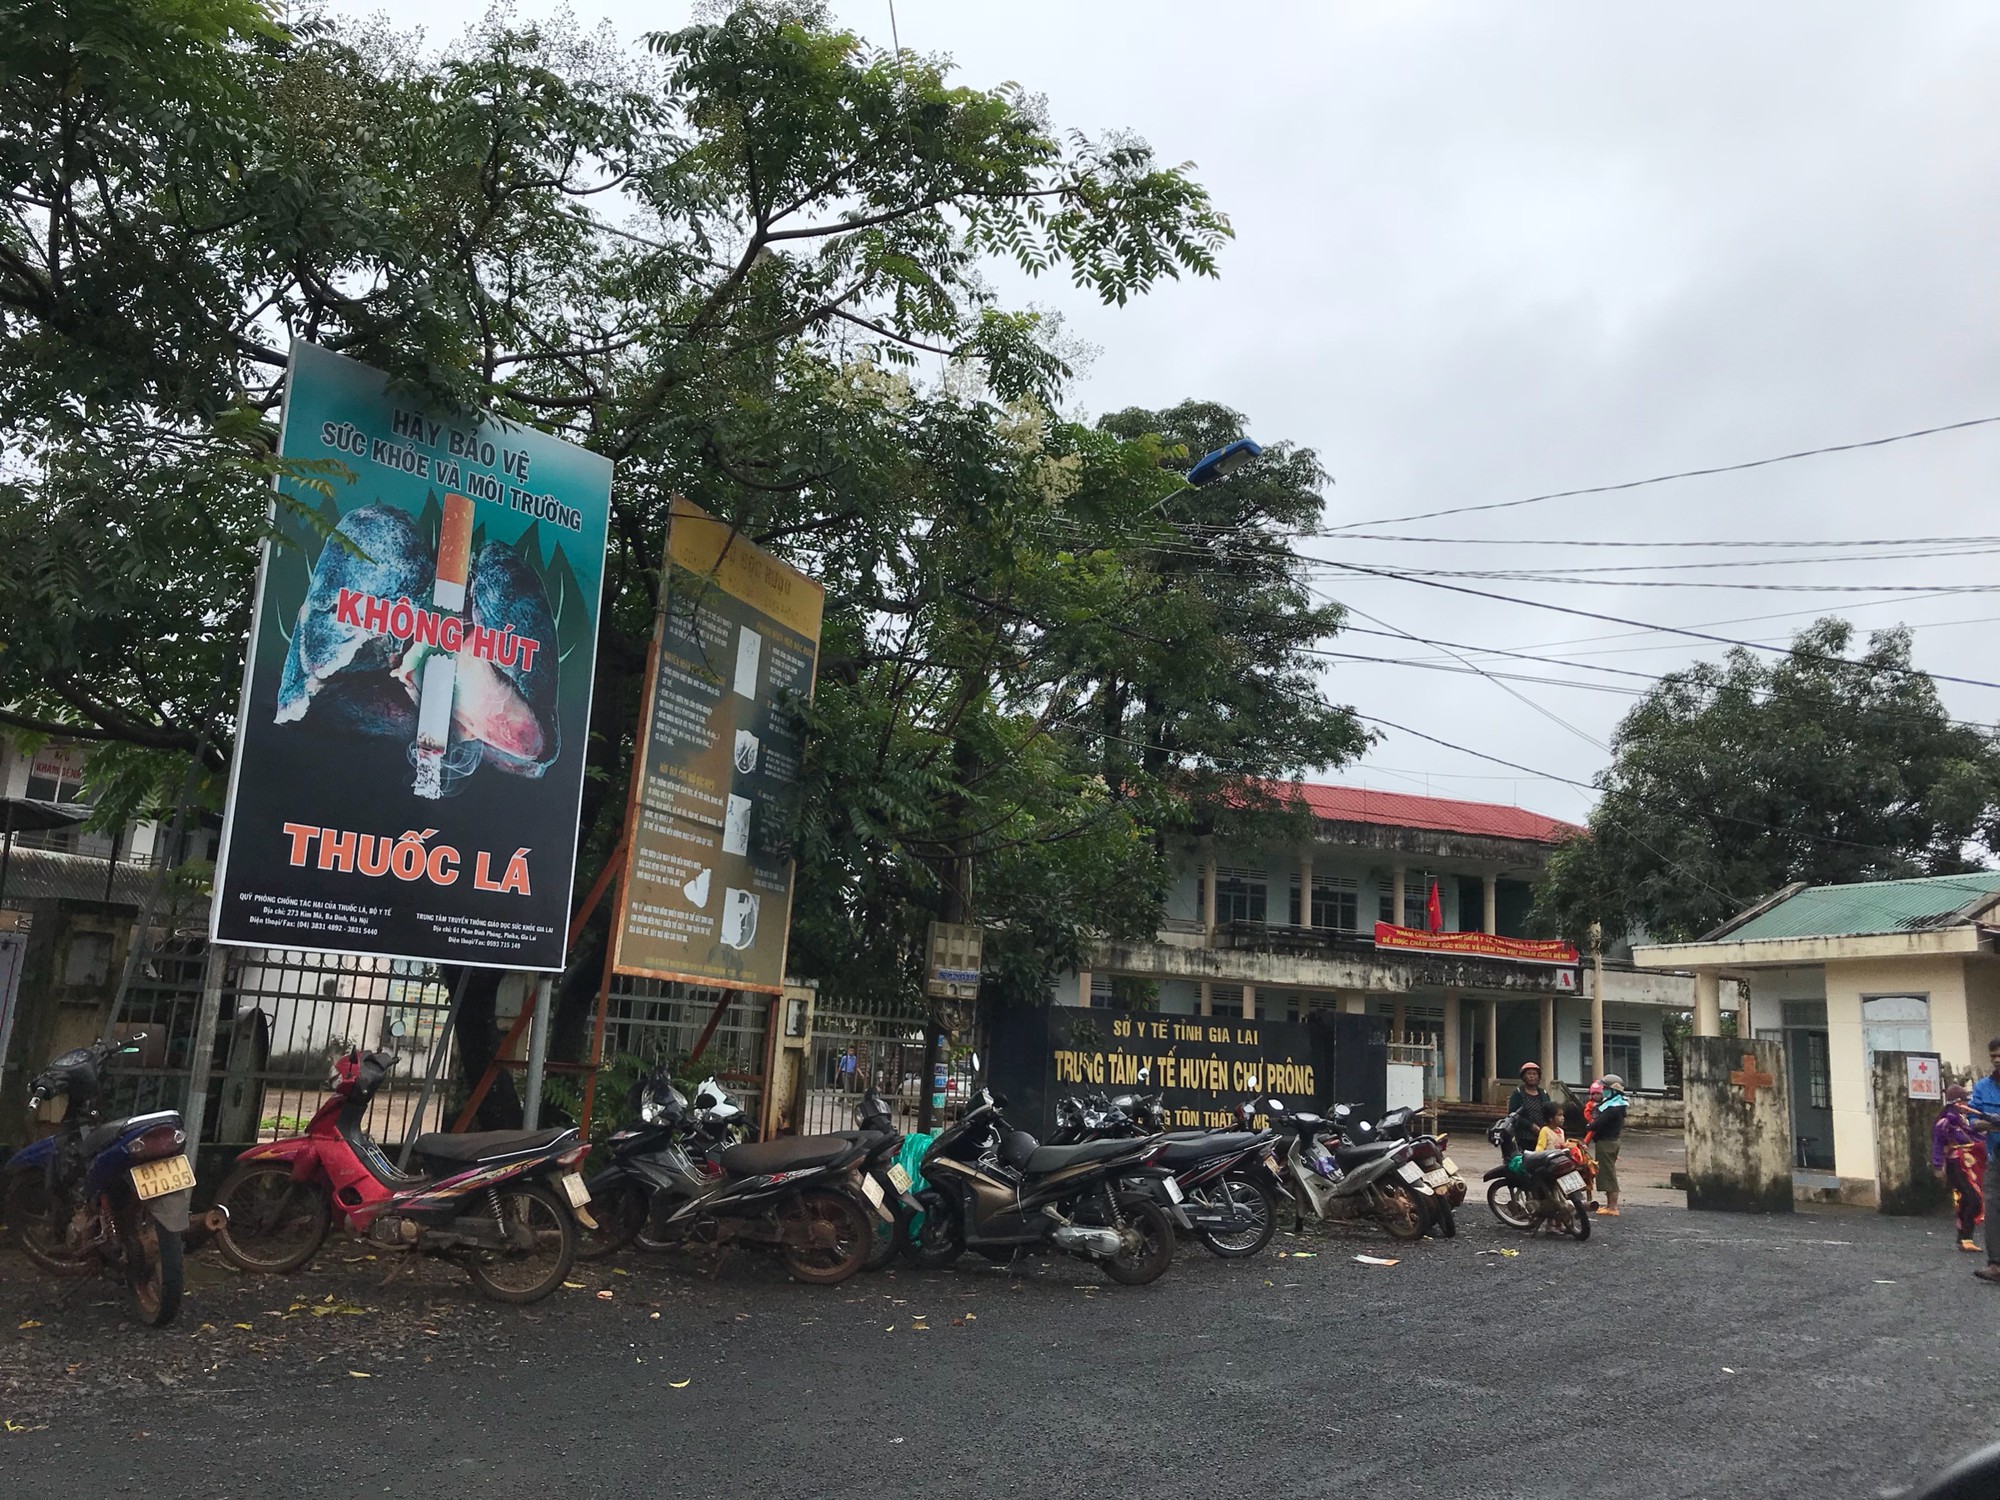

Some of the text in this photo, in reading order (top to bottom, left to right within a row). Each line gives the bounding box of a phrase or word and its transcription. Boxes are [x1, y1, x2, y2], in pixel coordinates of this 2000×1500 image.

[392, 407, 531, 484] HÃY BẢO VỆ
[321, 420, 582, 532] SỨC KHỎE VÀ MÔI TRƯỜNG
[336, 588, 540, 670] KHÔNG HÚT
[283, 821, 532, 896] THUỐC LÁ
[254, 894, 276, 904] PHÒNG
[277, 895, 298, 906] CHỐNG
[300, 898, 312, 908] TÁC
[313, 901, 323, 910] HẠI
[325, 900, 337, 910] CỦA
[338, 902, 358, 913] THUỐC
[384, 907, 393, 917] TẾ
[287, 909, 299, 917] 273
[300, 910, 312, 918] Kim
[325, 912, 333, 921] Ba
[296, 921, 310, 930] (04)
[311, 921, 326, 930] 3831
[327, 923, 342, 933] 4892
[347, 925, 362, 934] 3831
[363, 927, 378, 936] 5440
[416, 912, 434, 922] TRUNG
[435, 913, 447, 922] TÂM
[545, 926, 554, 934] LAI
[500, 941, 510, 949] 715
[520, 933, 529, 941] Gia
[1113, 1013, 1259, 1046] SỞ Y TẾ TỈNH GIA LAI
[1054, 1050, 1105, 1084] TRUNG
[1108, 1045, 1138, 1086] TÂM
[1157, 1045, 1177, 1088] TẾ
[1180, 1052, 1229, 1099] HUYỆN
[1233, 1057, 1265, 1093] CHƯ
[1266, 1056, 1316, 1096] PRÔNG
[1175, 1106, 1200, 1127] TÔN
[1203, 1105, 1232, 1129] THẤT
[142, 1171, 192, 1197] 170.95
